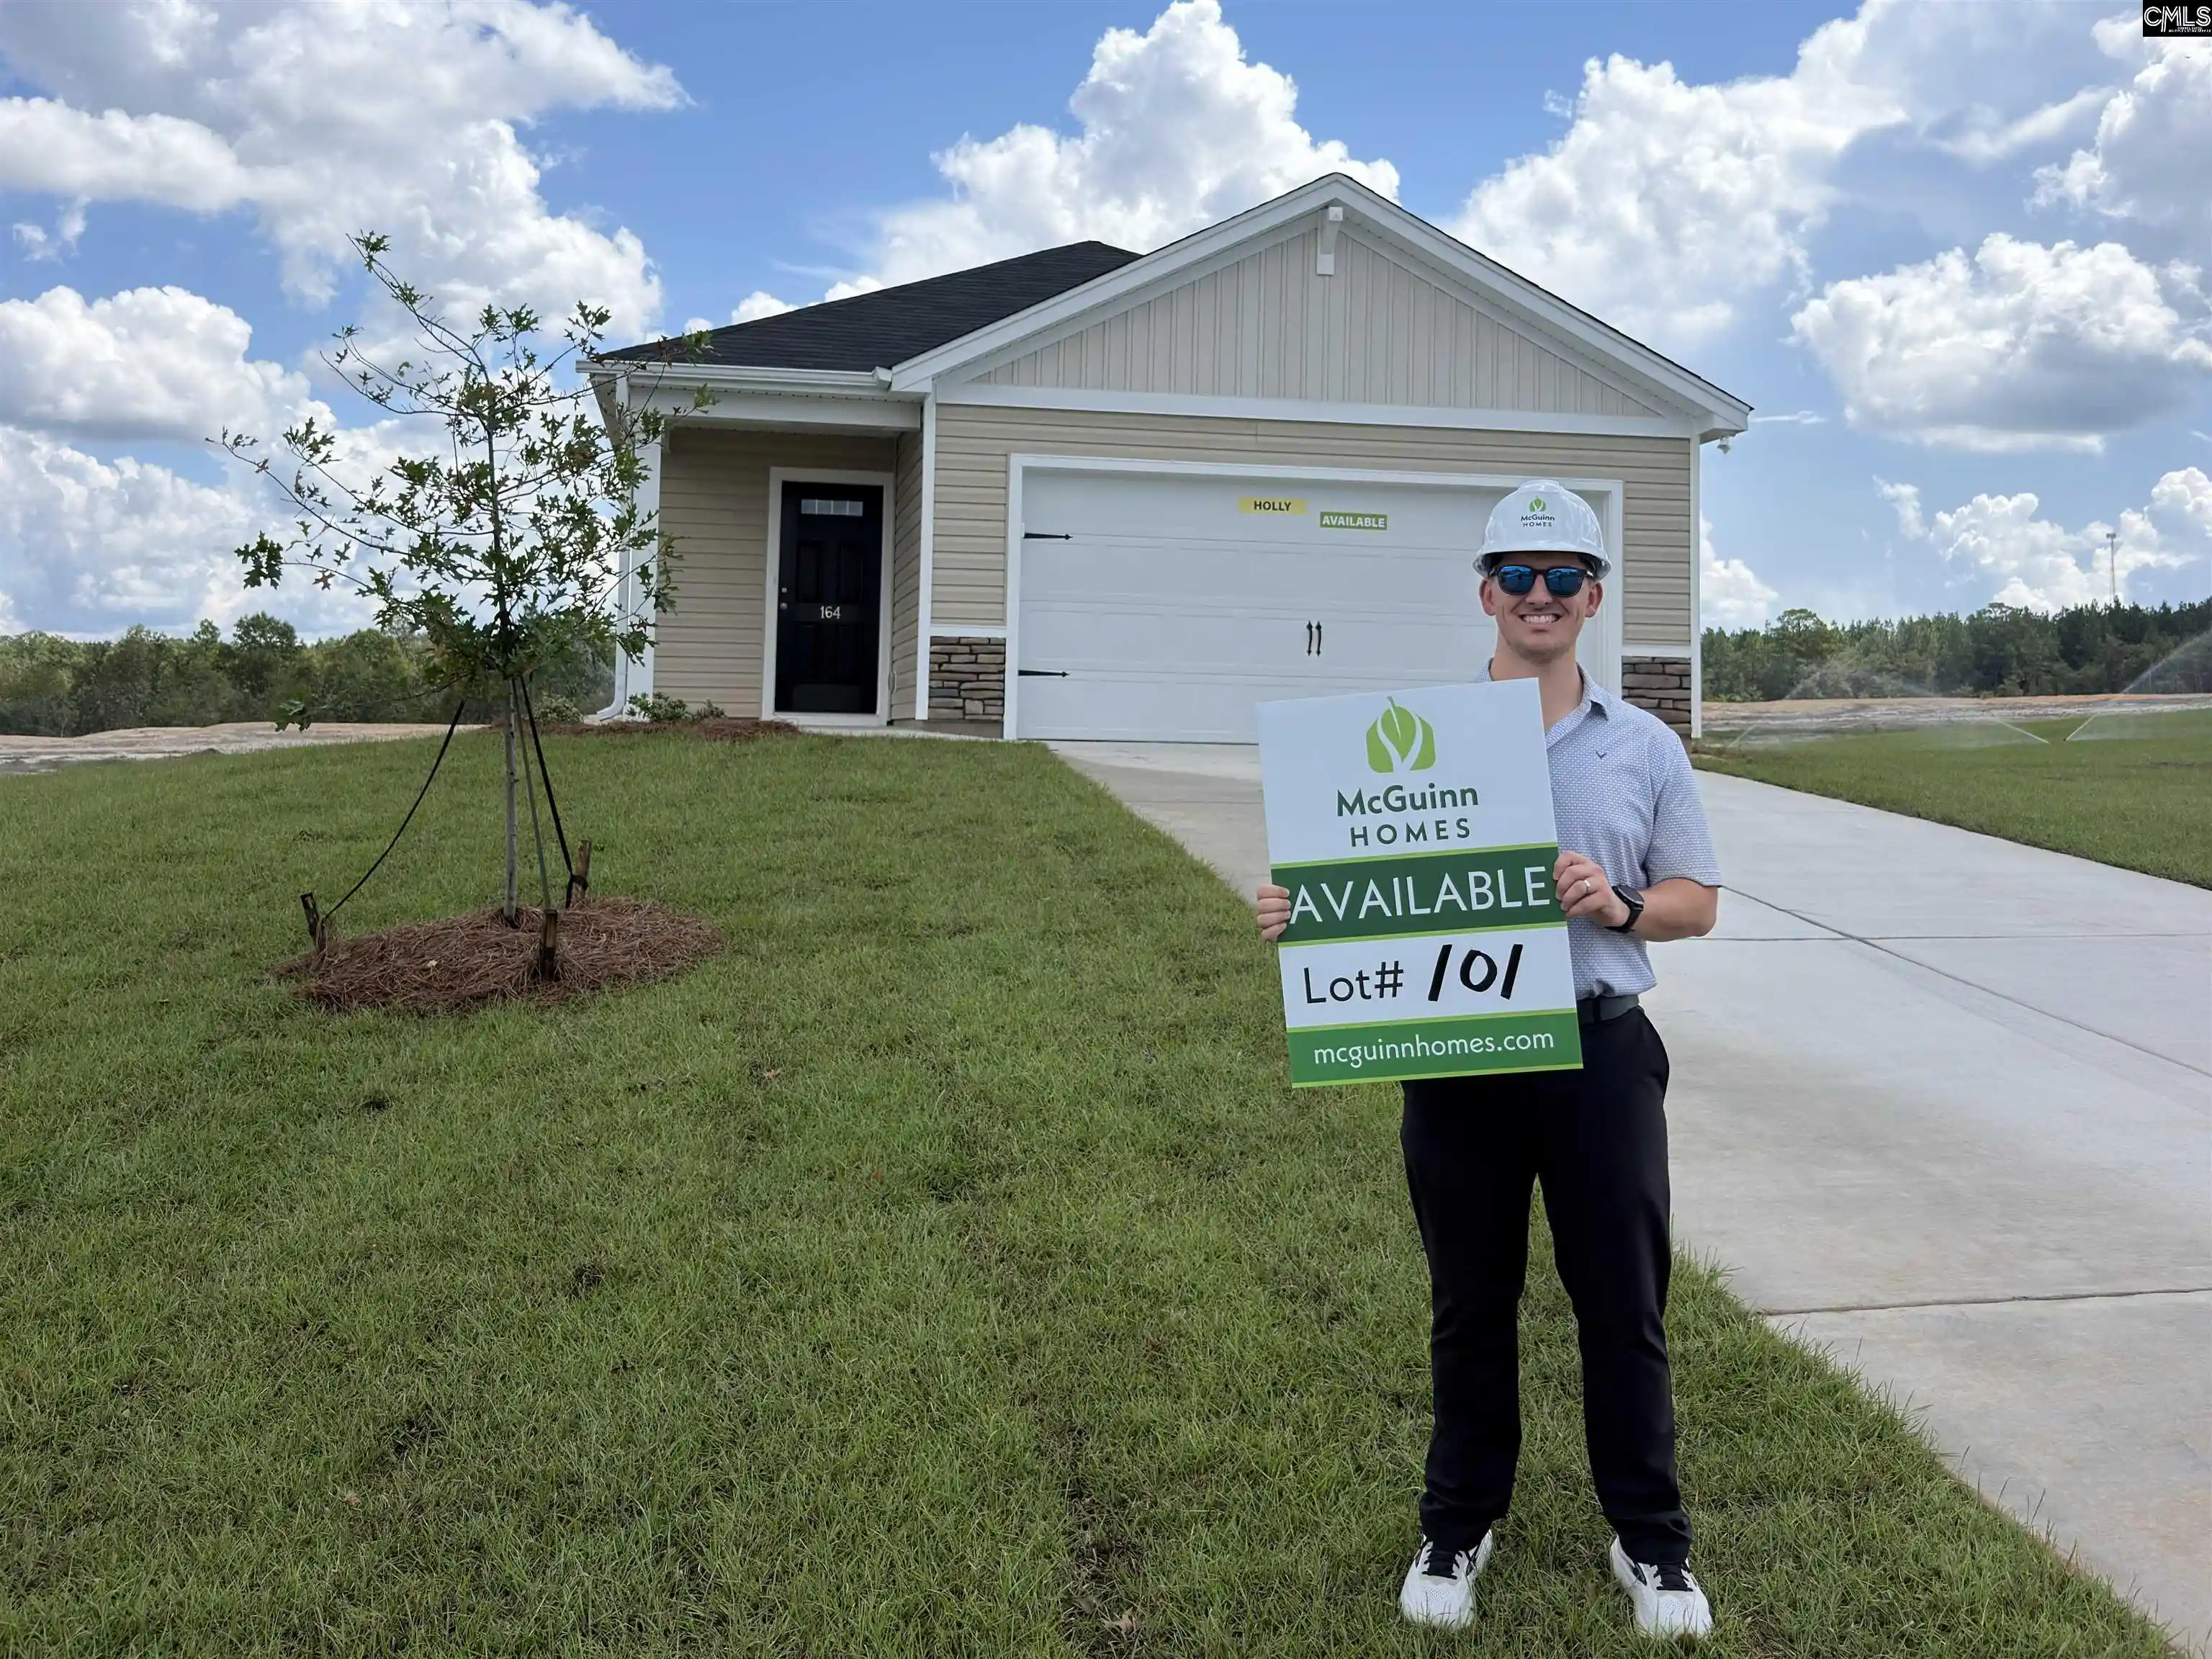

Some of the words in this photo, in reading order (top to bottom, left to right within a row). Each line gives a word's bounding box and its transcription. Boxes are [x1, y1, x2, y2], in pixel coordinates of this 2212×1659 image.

[1254, 500, 1292, 511] HOLLY
[1322, 515, 1385, 528] AVAILABLE
[820, 606, 841, 619] 164
[1336, 782, 1479, 817] McGuinn
[1349, 817, 1471, 848] HOMES
[1290, 866, 1550, 925] AVAILABLE
[1303, 960, 1404, 1004] Lot#
[1427, 943, 1524, 1002] 101
[1314, 1032, 1554, 1069] mcguinnhomes.com
